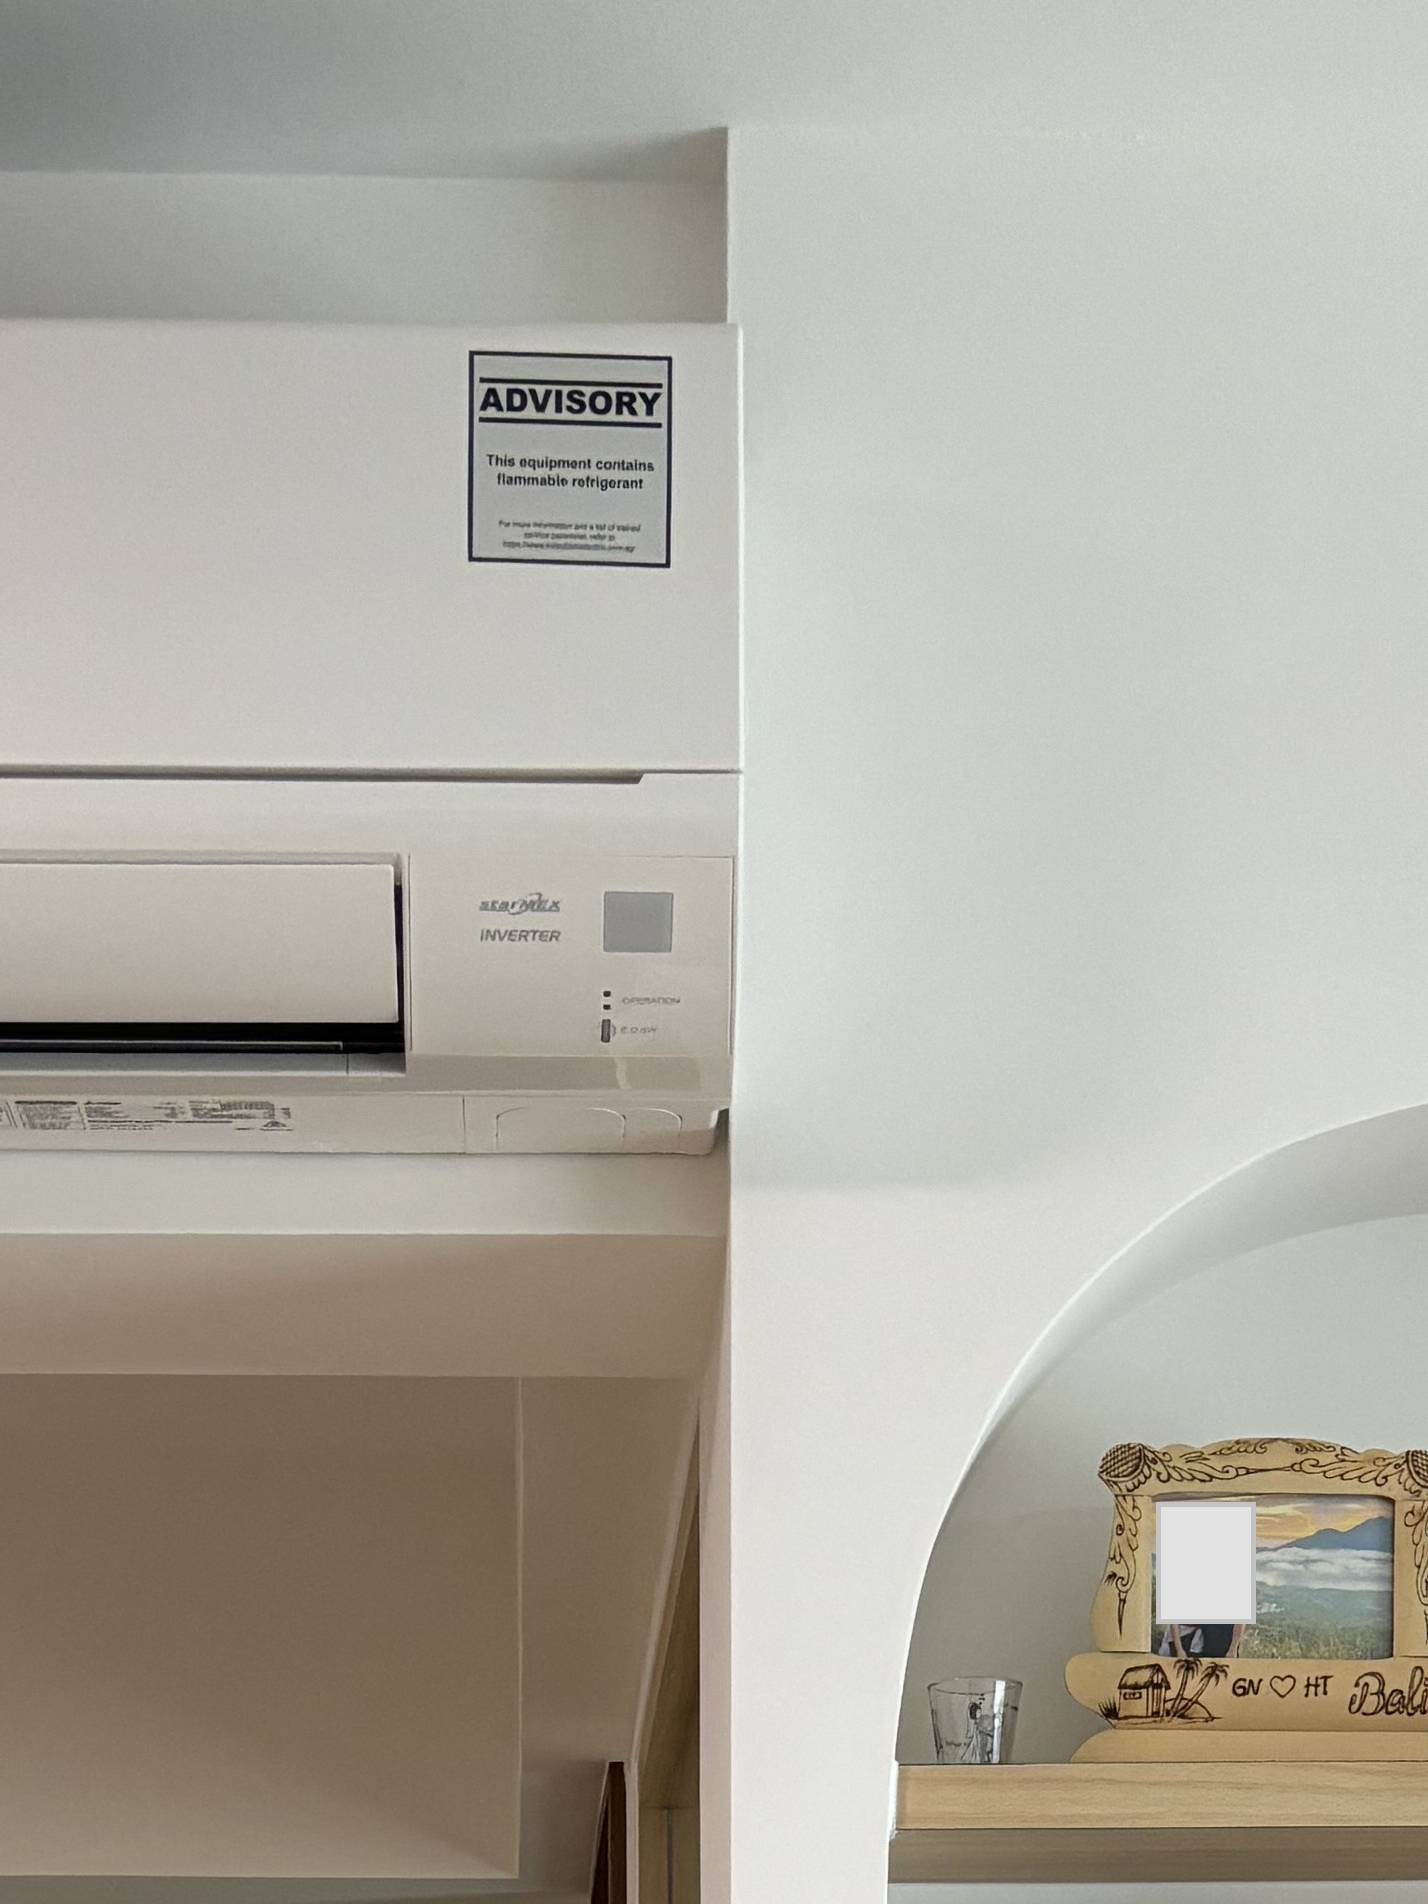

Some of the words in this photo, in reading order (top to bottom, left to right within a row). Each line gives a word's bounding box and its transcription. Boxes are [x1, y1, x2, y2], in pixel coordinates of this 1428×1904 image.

[479, 387, 663, 417] ADVISORY
[486, 453, 515, 468] This
[519, 457, 592, 472] equipment
[595, 459, 655, 472] contains
[497, 473, 568, 487] flammable
[571, 475, 644, 491] refrigerant
[480, 929, 562, 943] INVERTER
[1232, 1678, 1263, 1698] GN
[1304, 1675, 1333, 1698] HT
